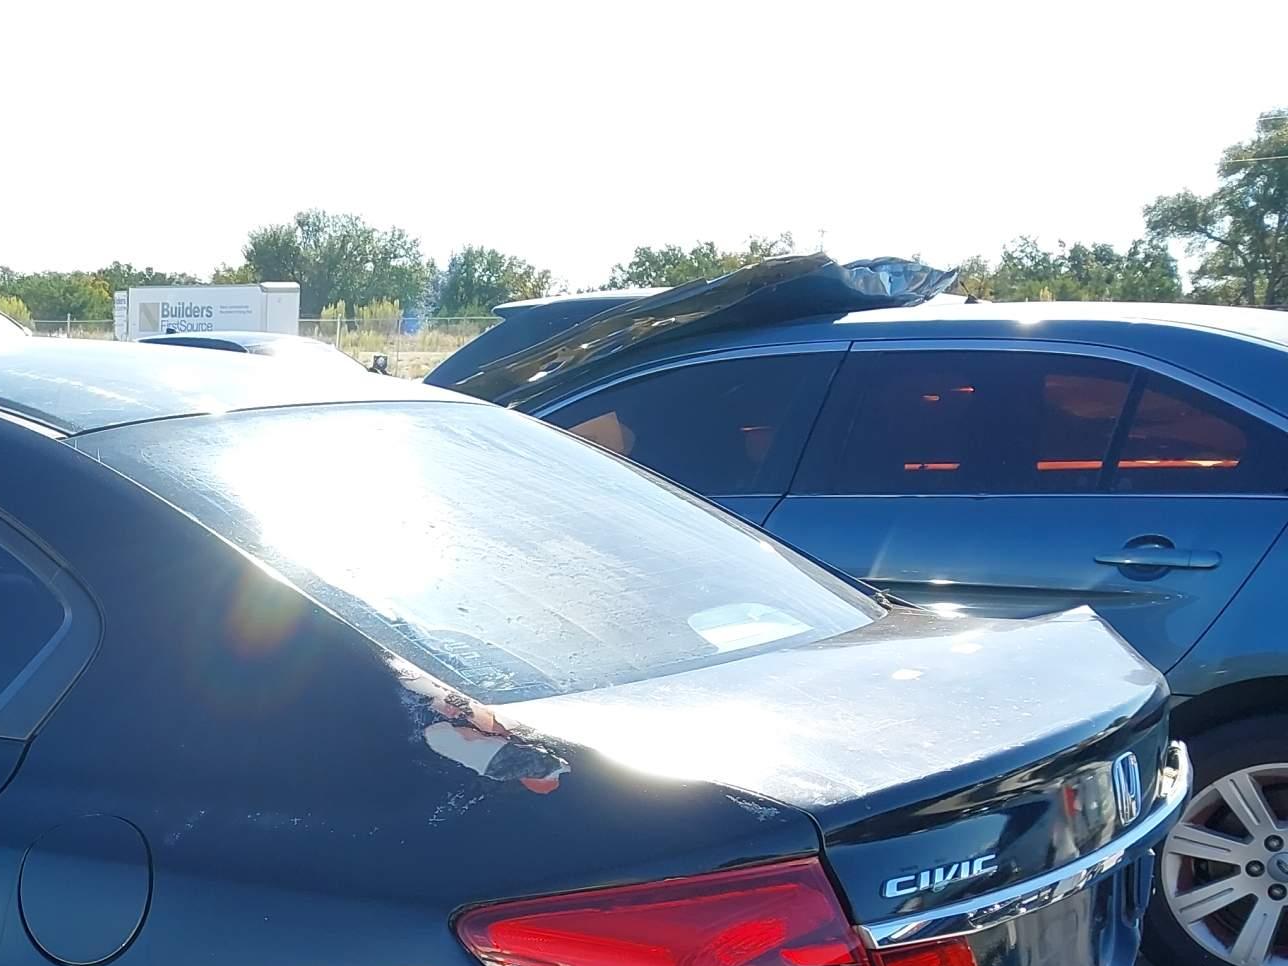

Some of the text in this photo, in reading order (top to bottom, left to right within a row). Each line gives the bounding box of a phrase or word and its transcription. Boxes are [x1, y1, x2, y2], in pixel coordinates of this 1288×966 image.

[161, 302, 213, 318] Builders
[161, 319, 213, 332] FirstSource
[883, 854, 999, 898] CIVIC
